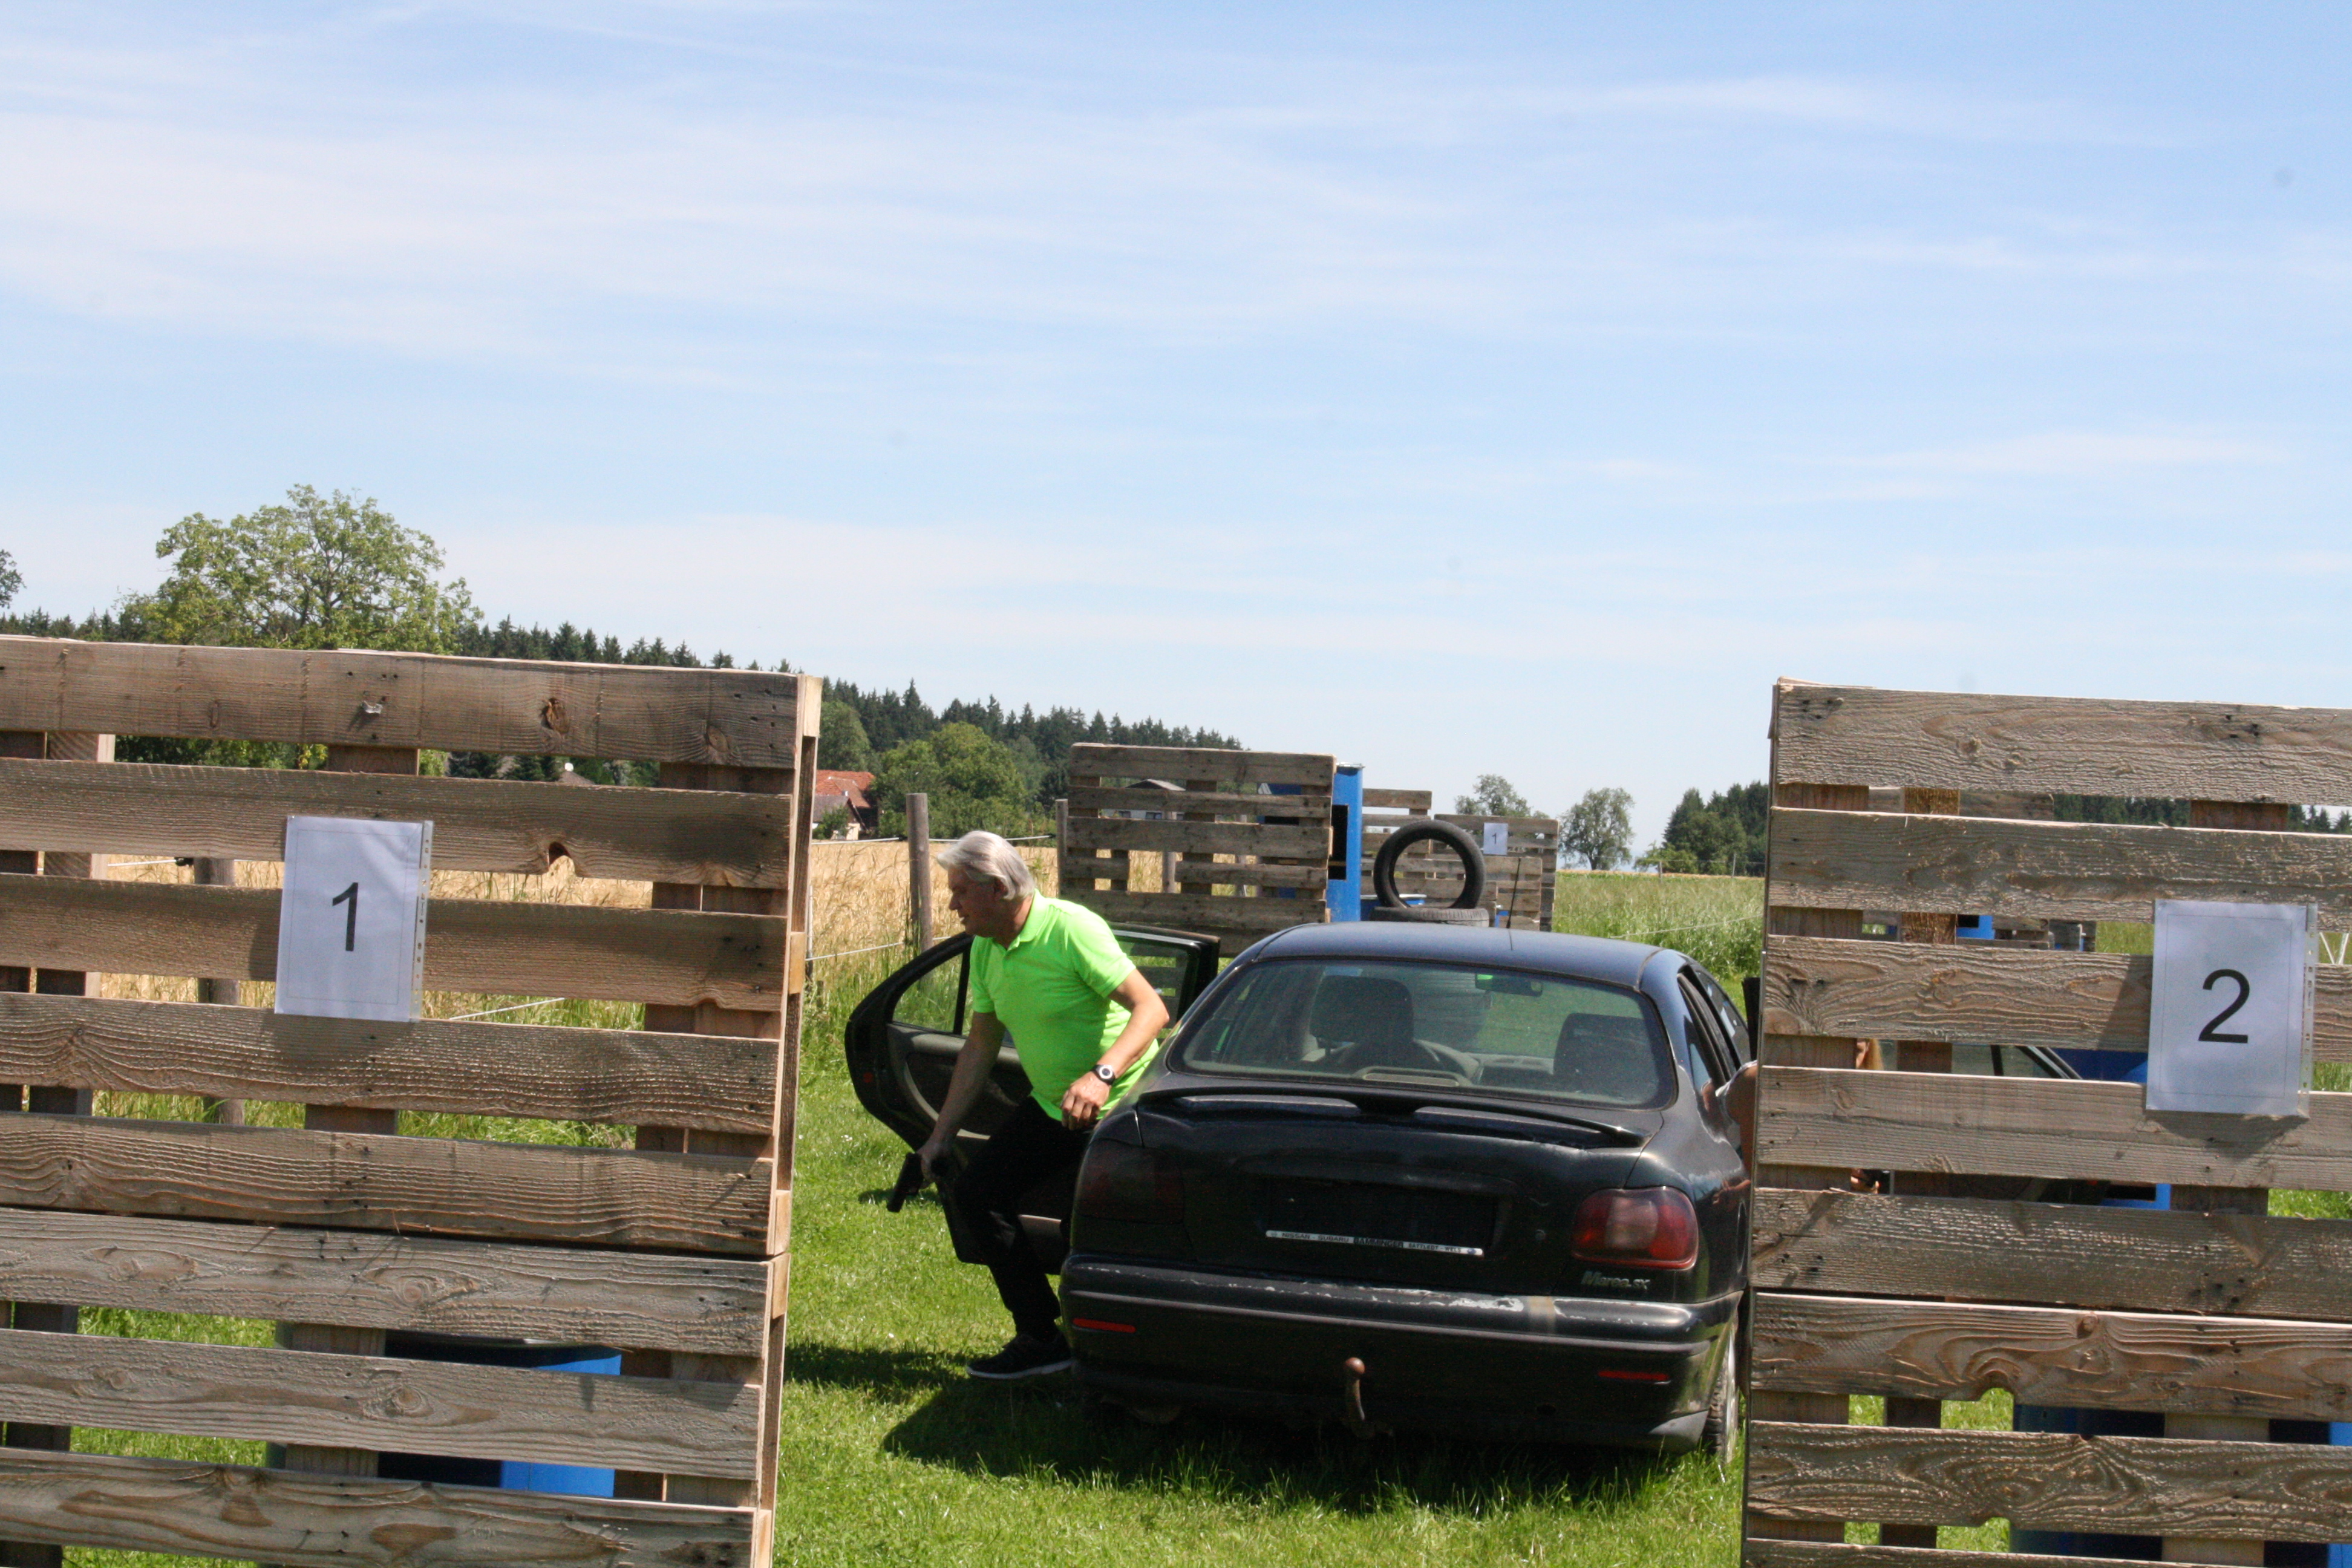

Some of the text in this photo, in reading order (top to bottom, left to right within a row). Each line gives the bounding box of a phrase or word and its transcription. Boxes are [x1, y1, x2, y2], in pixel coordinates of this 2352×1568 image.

[1492, 832, 1497, 844] 1
[332, 882, 359, 952] 1
[2198, 969, 2250, 1044] 2
